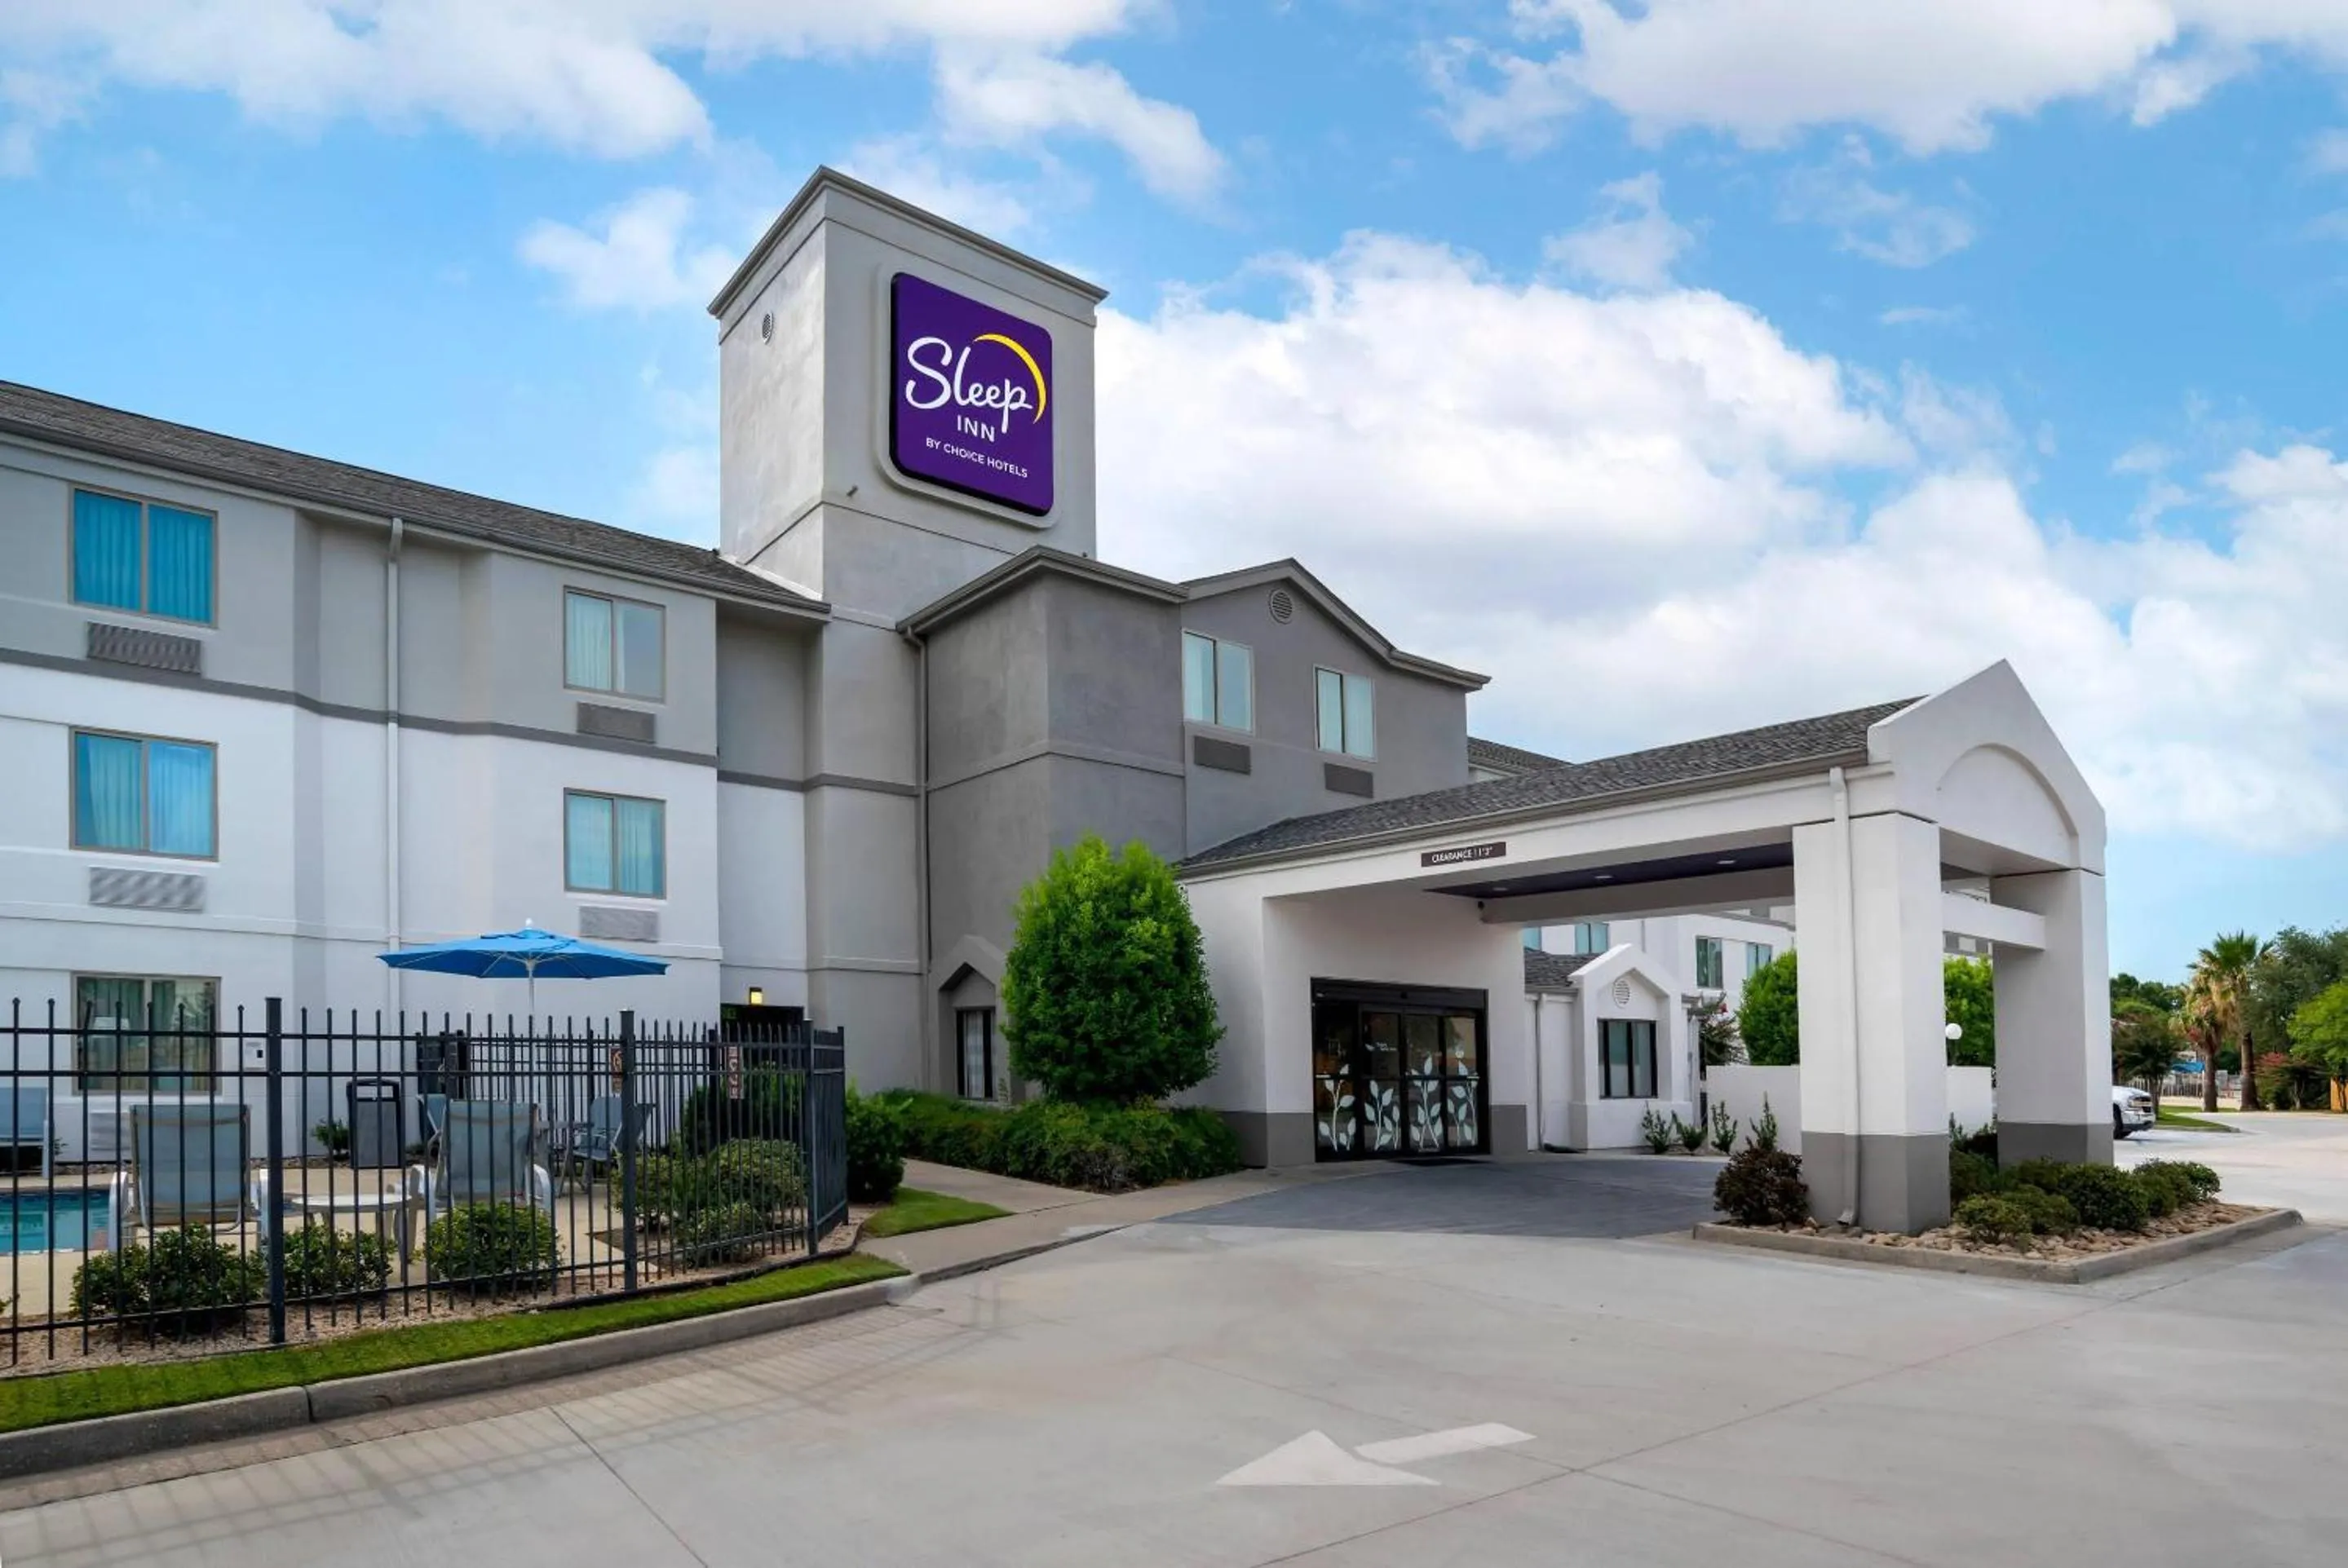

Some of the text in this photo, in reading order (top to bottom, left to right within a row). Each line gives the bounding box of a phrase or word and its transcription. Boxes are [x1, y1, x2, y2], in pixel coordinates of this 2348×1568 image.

[905, 336, 1033, 434] Sleep
[957, 414, 995, 442] INN
[926, 437, 1028, 478] BY CHOICE HOTELS
[1431, 849, 1472, 864] CLEARANCE
